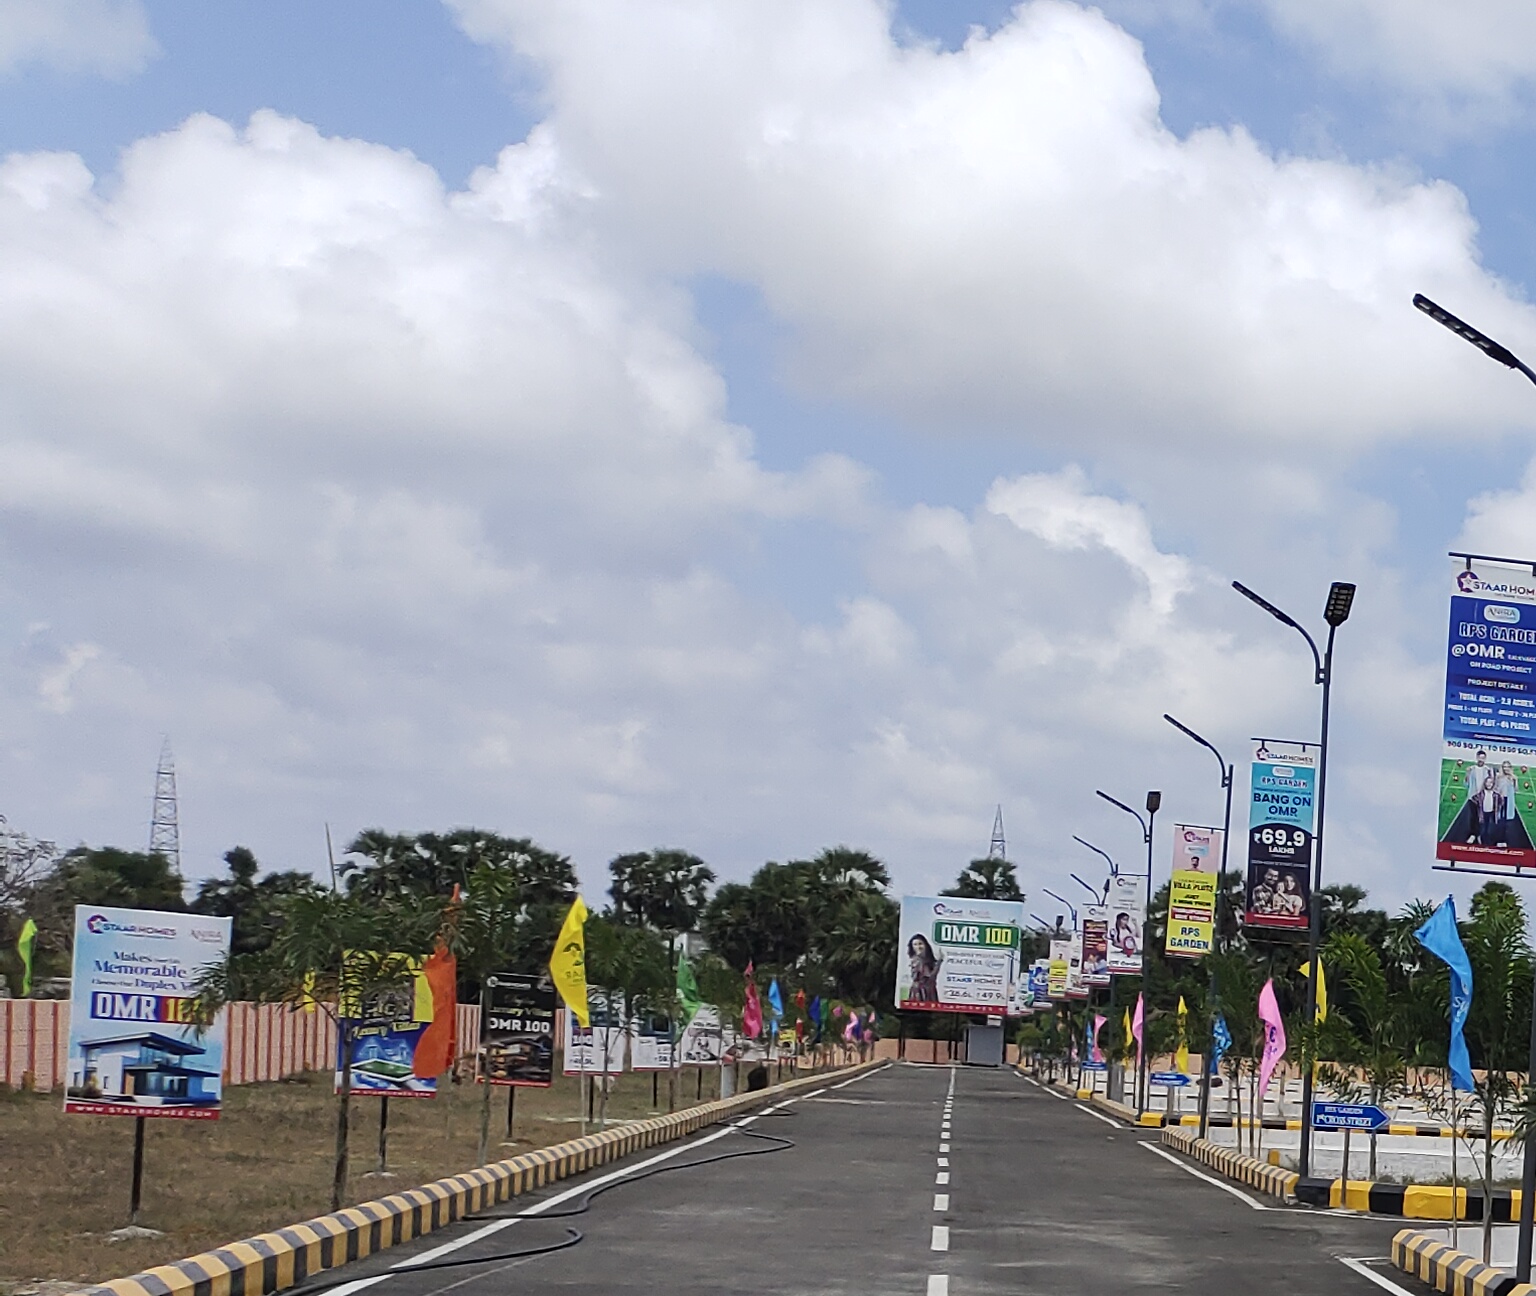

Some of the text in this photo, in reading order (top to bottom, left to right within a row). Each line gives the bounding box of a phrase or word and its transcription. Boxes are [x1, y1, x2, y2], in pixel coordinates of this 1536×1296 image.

[1459, 622, 1487, 639] RPS
[1451, 642, 1506, 660] @OMR
[1253, 792, 1312, 807] BANG ON
[1268, 805, 1298, 818] OMR
[941, 924, 1012, 946] OMR 100
[1180, 926, 1200, 938] RPS
[1170, 936, 1209, 950] GARDEN
[113, 951, 153, 963] Makes
[93, 960, 187, 979] Memorable
[524, 1020, 550, 1033] 100
